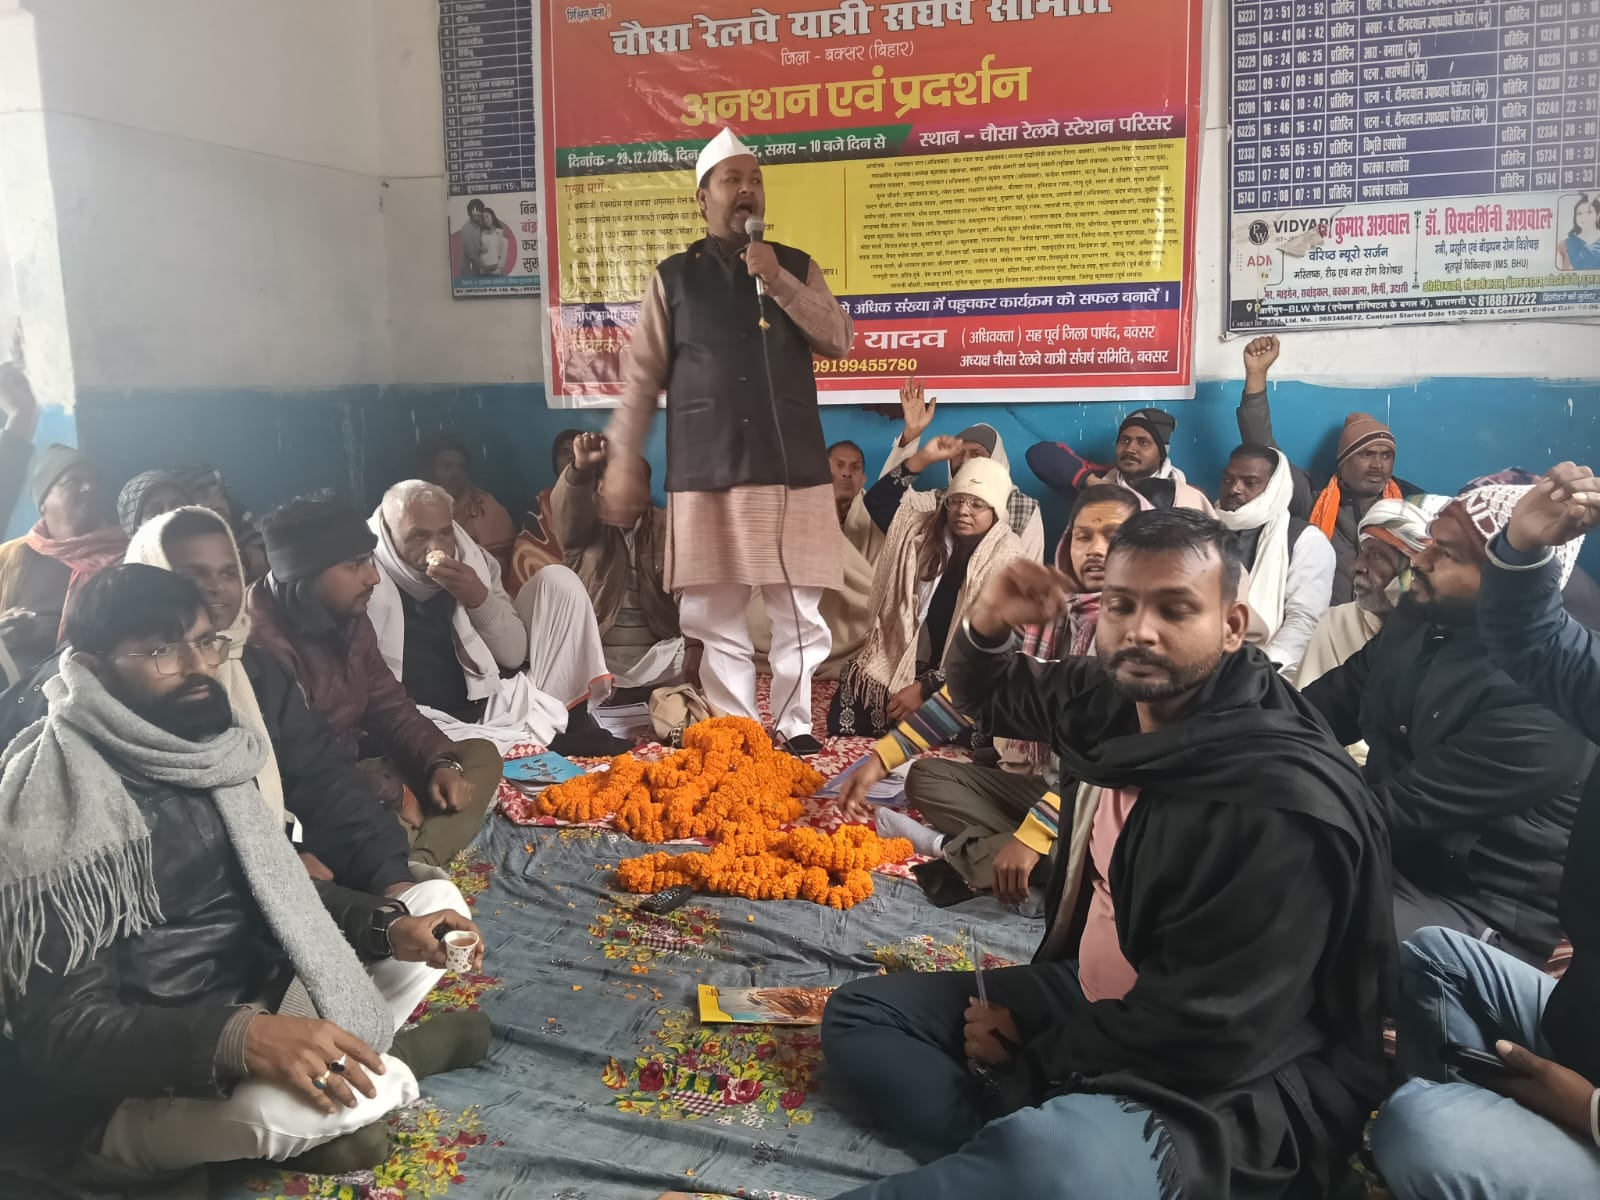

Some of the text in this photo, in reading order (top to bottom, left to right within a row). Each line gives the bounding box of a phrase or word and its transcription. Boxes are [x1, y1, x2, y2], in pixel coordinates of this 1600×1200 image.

[1264, 8, 1273, 20] 23
[1281, 6, 1291, 18] 51
[1296, 4, 1306, 17] 23
[1314, 3, 1324, 16] 52
[609, 21, 692, 56] चौसा
[693, 12, 779, 47] रेलवे
[787, 0, 874, 39] यात्री
[1263, 30, 1273, 43] 04
[1282, 29, 1291, 42] 41
[1296, 27, 1306, 40] 04
[1314, 26, 1324, 39] 42
[1331, 21, 1354, 39] प्रतिदिन
[781, 39, 914, 66] जिला बक्सर (बिहार)
[1331, 45, 1354, 62] प्रतिदिन
[1330, 69, 1354, 85] प्रतिदिन
[680, 53, 1032, 126] अनशन एवं प्रदर्शन
[1330, 92, 1354, 109] प्रतिदिन
[919, 112, 1173, 147] स्थान चौसा रेलवे स्टेशन परिसर
[1330, 115, 1353, 131] प्रतिदिन
[568, 152, 605, 168] दिनांक
[765, 143, 796, 156] समय
[810, 140, 820, 152] 10
[823, 136, 844, 152] बजे
[847, 135, 871, 151] दिन
[873, 134, 886, 149] से
[1330, 139, 1353, 155] प्रतिदिन
[1329, 162, 1352, 177] प्रतिदिन
[1329, 184, 1352, 200] प्रतिदिन
[1335, 216, 1363, 244] कुमार
[1367, 213, 1410, 237] अग्रवाल
[1425, 204, 1552, 235] डॉ. प्रियदर्शिनी अग्रवाल
[1309, 244, 1388, 262] वरिष्ठ न्यूरो सर्जन
[1450, 239, 1466, 256] प्रसूति
[1503, 237, 1514, 251] रोग
[1365, 264, 1377, 276] रोग
[854, 300, 892, 315] अधिक
[895, 298, 930, 313] संख्या
[933, 296, 946, 311] में
[1000, 292, 1053, 309] कार्यक्रम
[1057, 292, 1075, 306] को
[1079, 292, 1120, 305] सफल
[1122, 287, 1161, 304] बनावें
[1478, 293, 1537, 306] 8188877222
[864, 323, 1156, 350] यादव अधिवक्ता सह पूर्व जिला पार्षद, बक्सर
[960, 347, 1169, 367] अध्यक्ष चौसा रेलवे यात्री संघर्ष समिति, बक्सर
